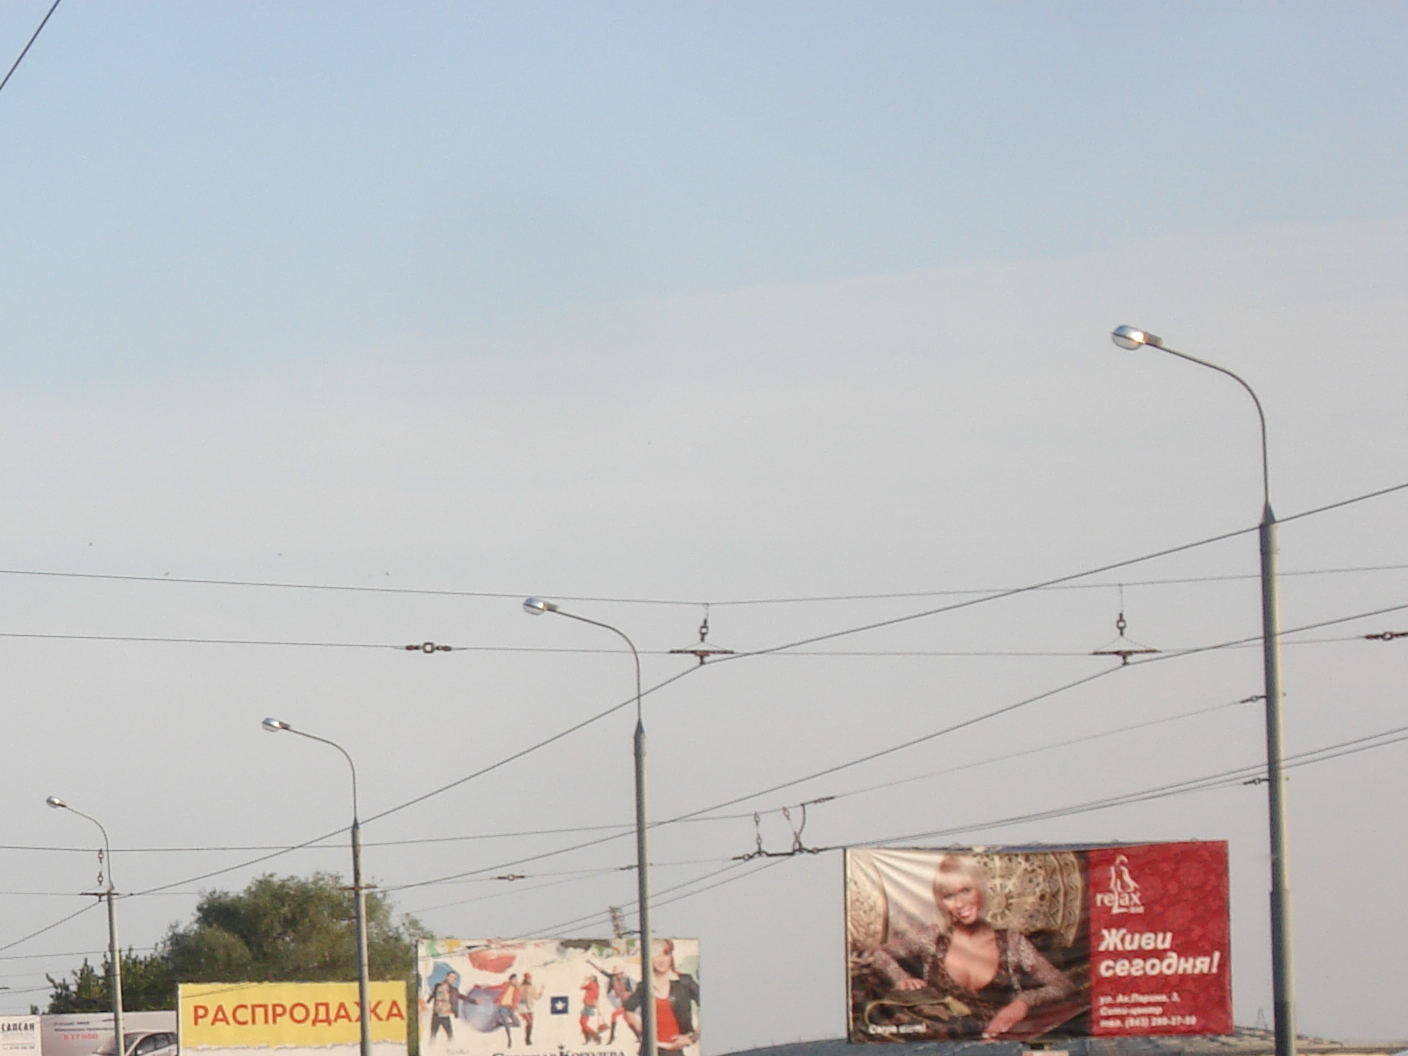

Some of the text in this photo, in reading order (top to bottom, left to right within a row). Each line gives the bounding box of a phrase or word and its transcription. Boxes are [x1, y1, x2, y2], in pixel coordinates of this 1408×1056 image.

[1098, 928, 1173, 951] Живи
[1099, 950, 1221, 977] сегодня!
[193, 1000, 406, 1027] РАСПРОДАЖА
[1, 1022, 35, 1032] САПСАН
